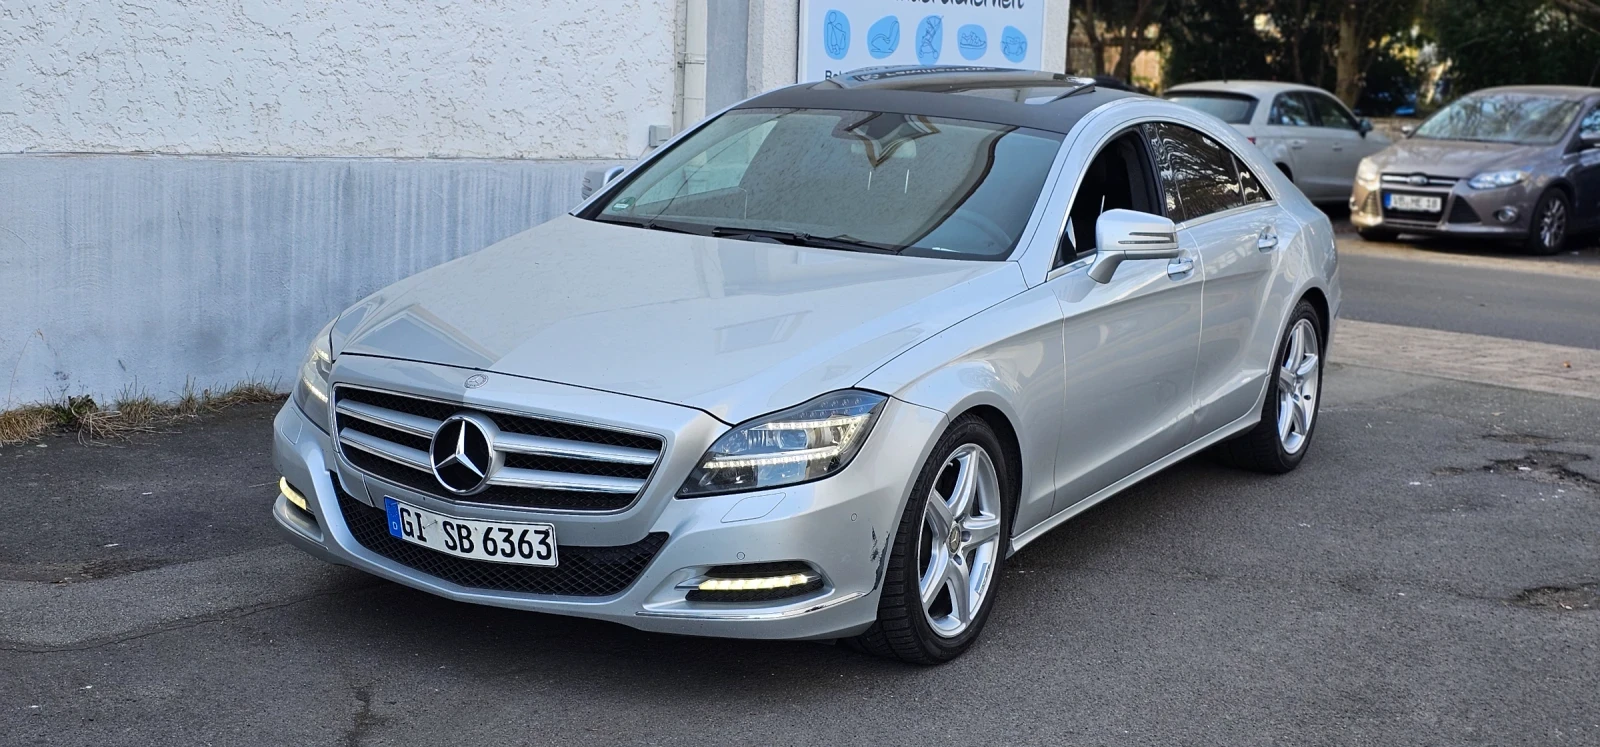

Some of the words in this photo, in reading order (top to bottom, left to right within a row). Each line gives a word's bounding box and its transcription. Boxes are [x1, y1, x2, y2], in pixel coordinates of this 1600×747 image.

[392, 521, 398, 531] D
[400, 507, 427, 542] GI
[442, 520, 475, 554] SB
[482, 526, 552, 560] 6363
